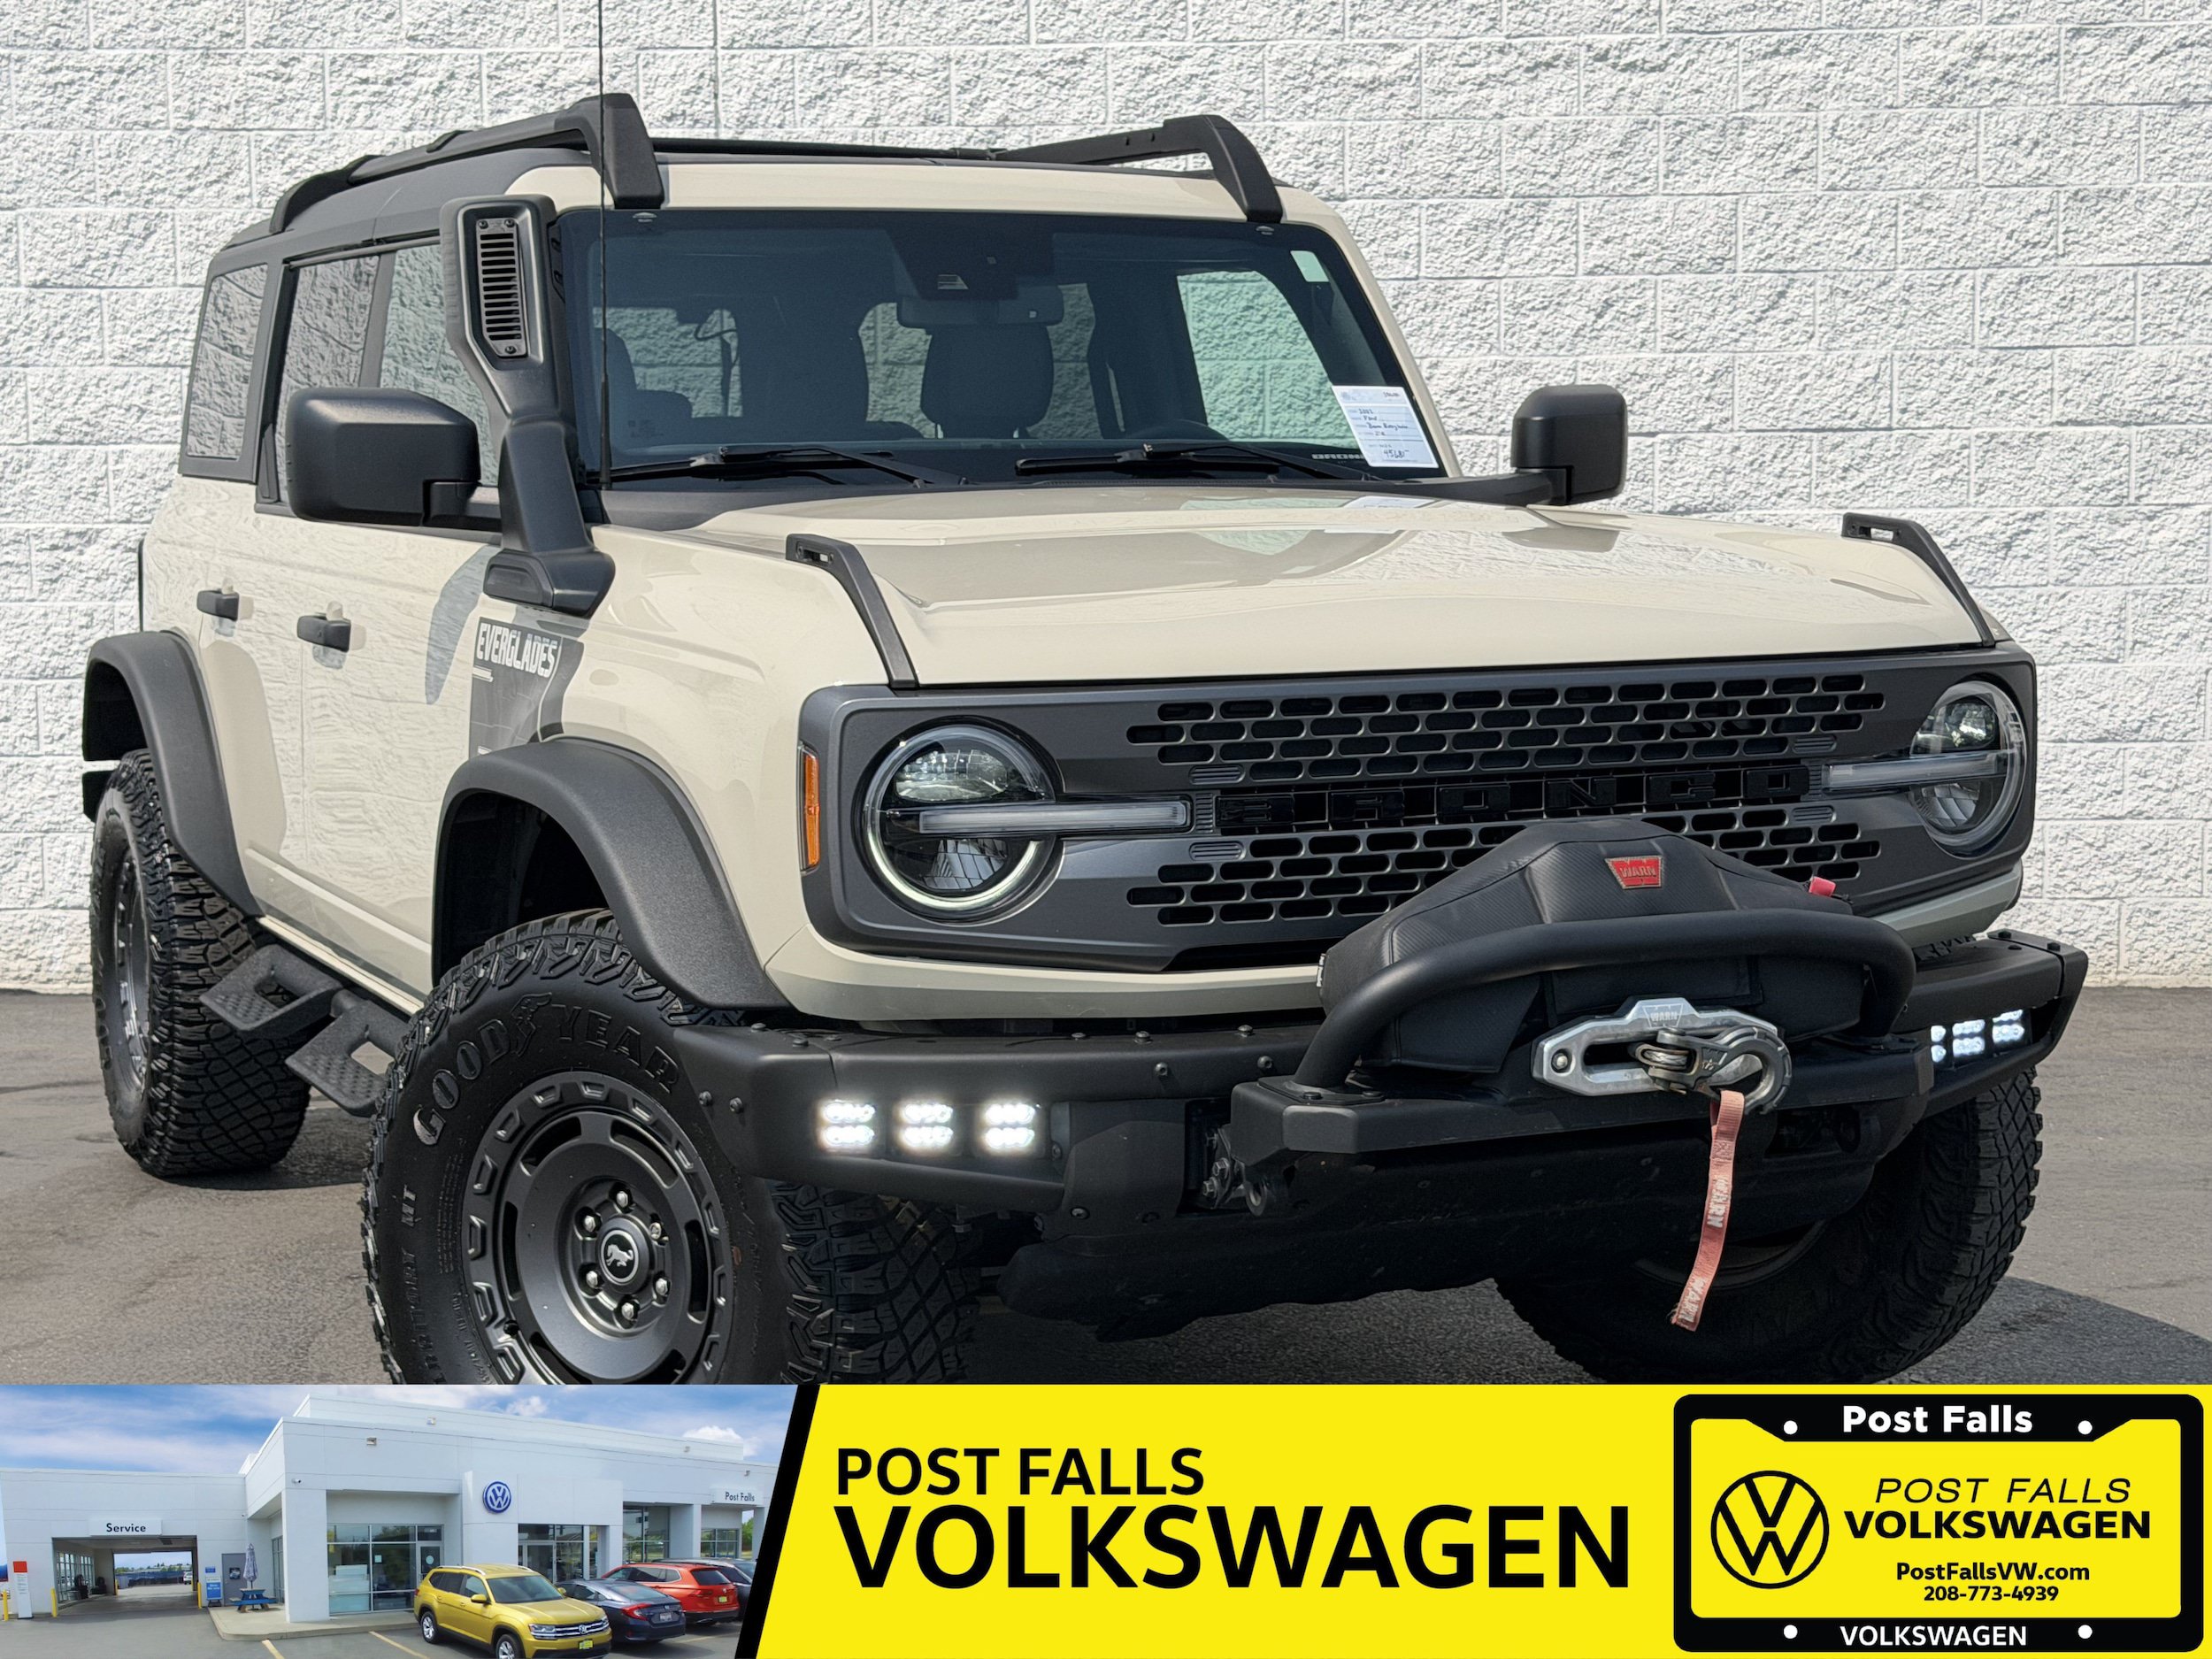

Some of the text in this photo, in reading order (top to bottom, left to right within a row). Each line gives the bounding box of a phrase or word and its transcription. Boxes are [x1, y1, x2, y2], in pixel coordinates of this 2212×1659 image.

[476, 622, 558, 678] EVERGLADES
[1215, 765, 1809, 826] BRONCO
[1619, 865, 1656, 877] WARN
[1650, 1011, 1678, 1022] WARN
[1706, 1174, 1729, 1228] WARN
[1678, 1276, 1707, 1323] WARN
